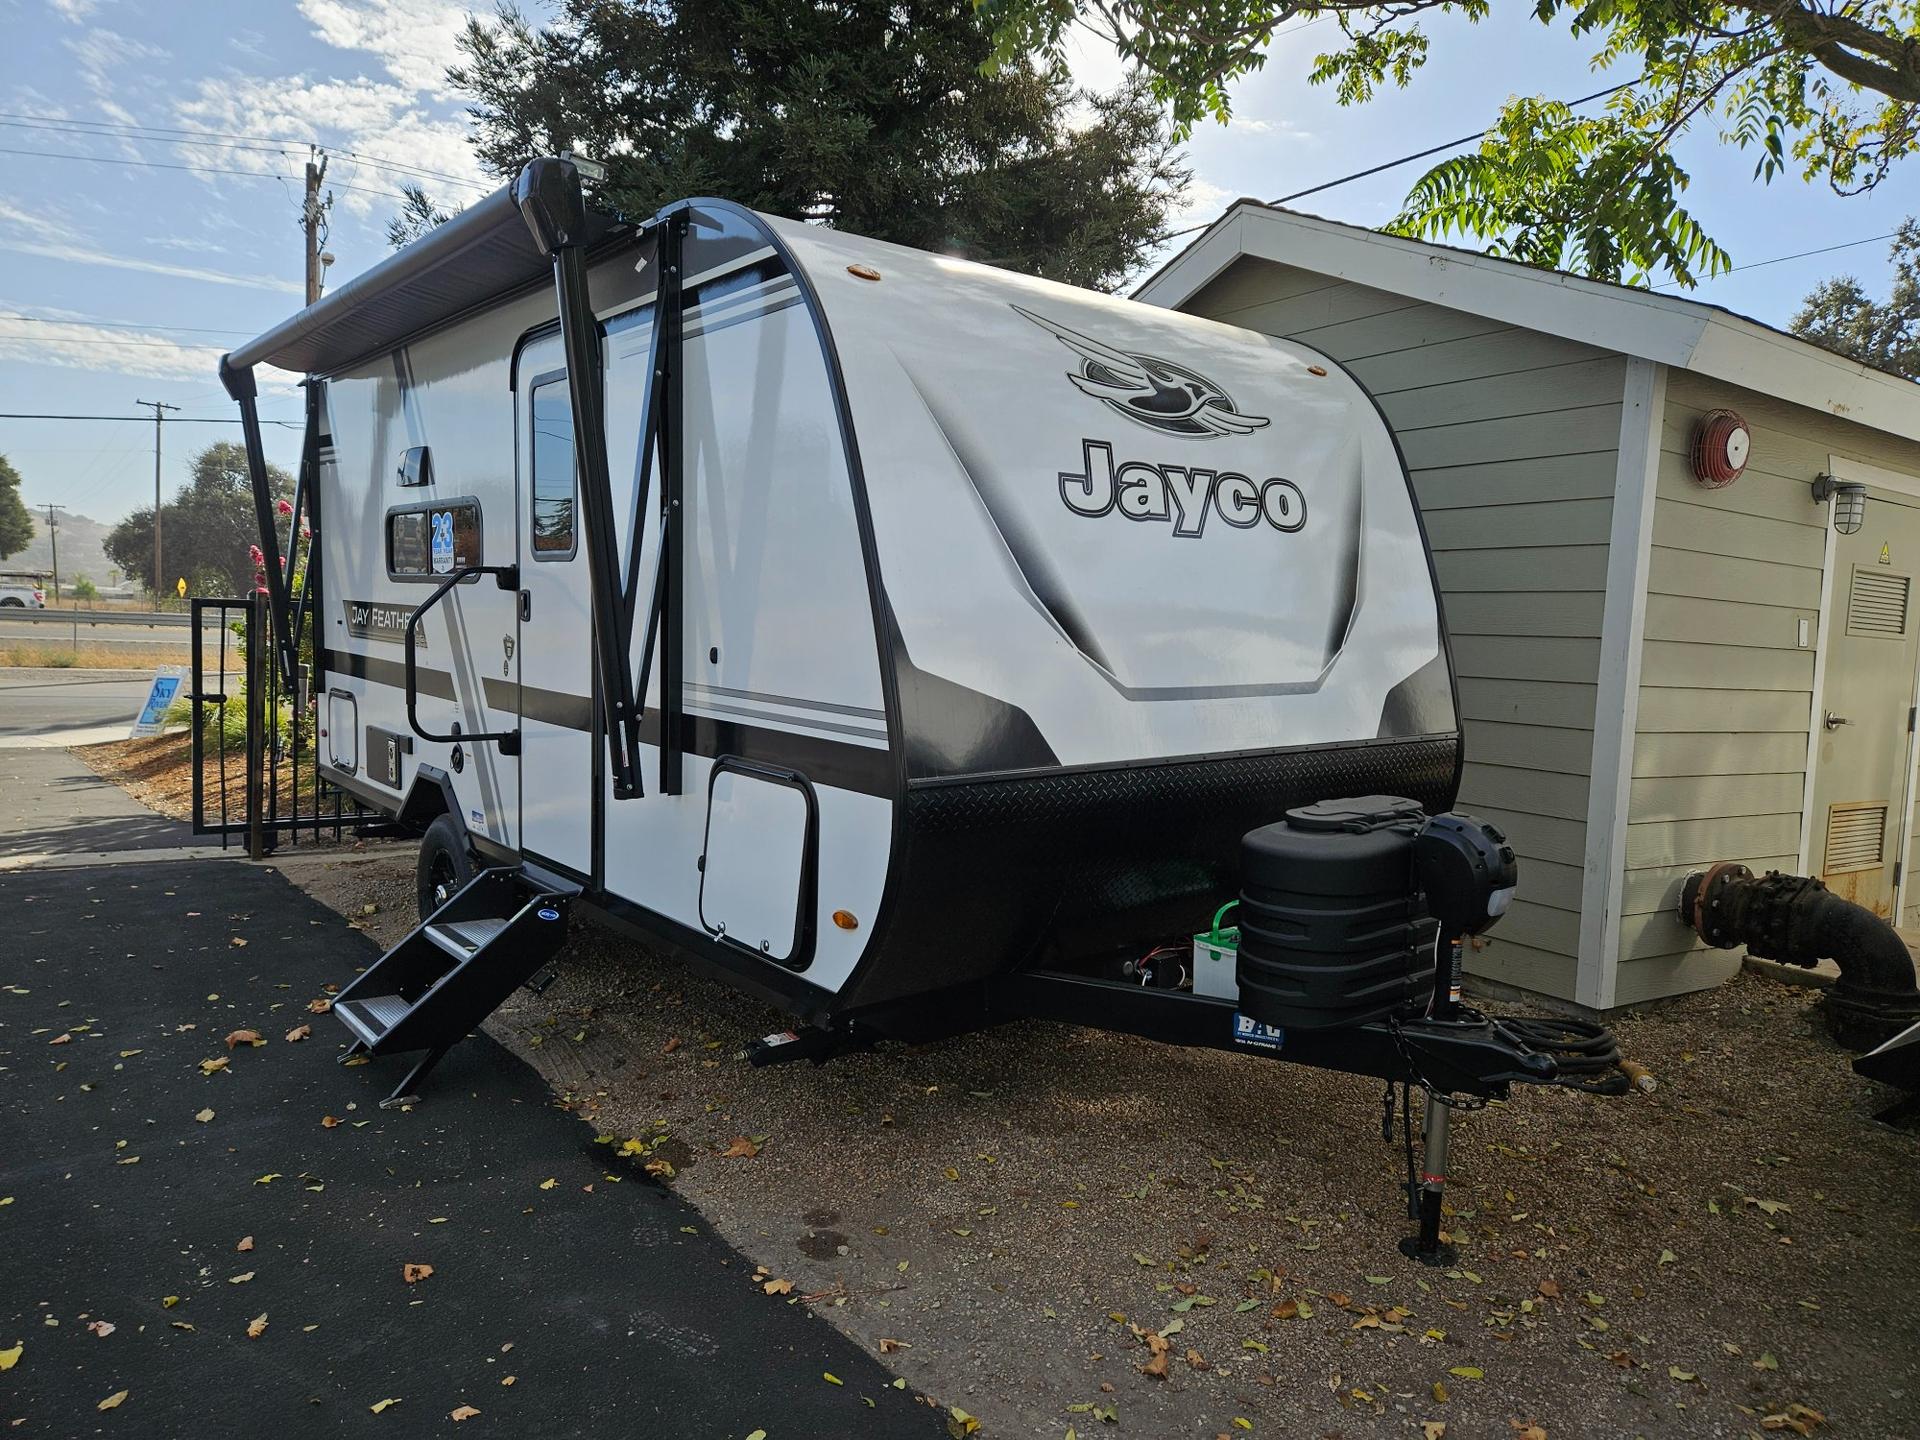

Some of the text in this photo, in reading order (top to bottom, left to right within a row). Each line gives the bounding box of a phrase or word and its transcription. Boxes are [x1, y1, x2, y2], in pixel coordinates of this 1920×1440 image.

[1058, 438, 1308, 538] Jayco
[351, 606, 419, 631] JAY FEATHE
